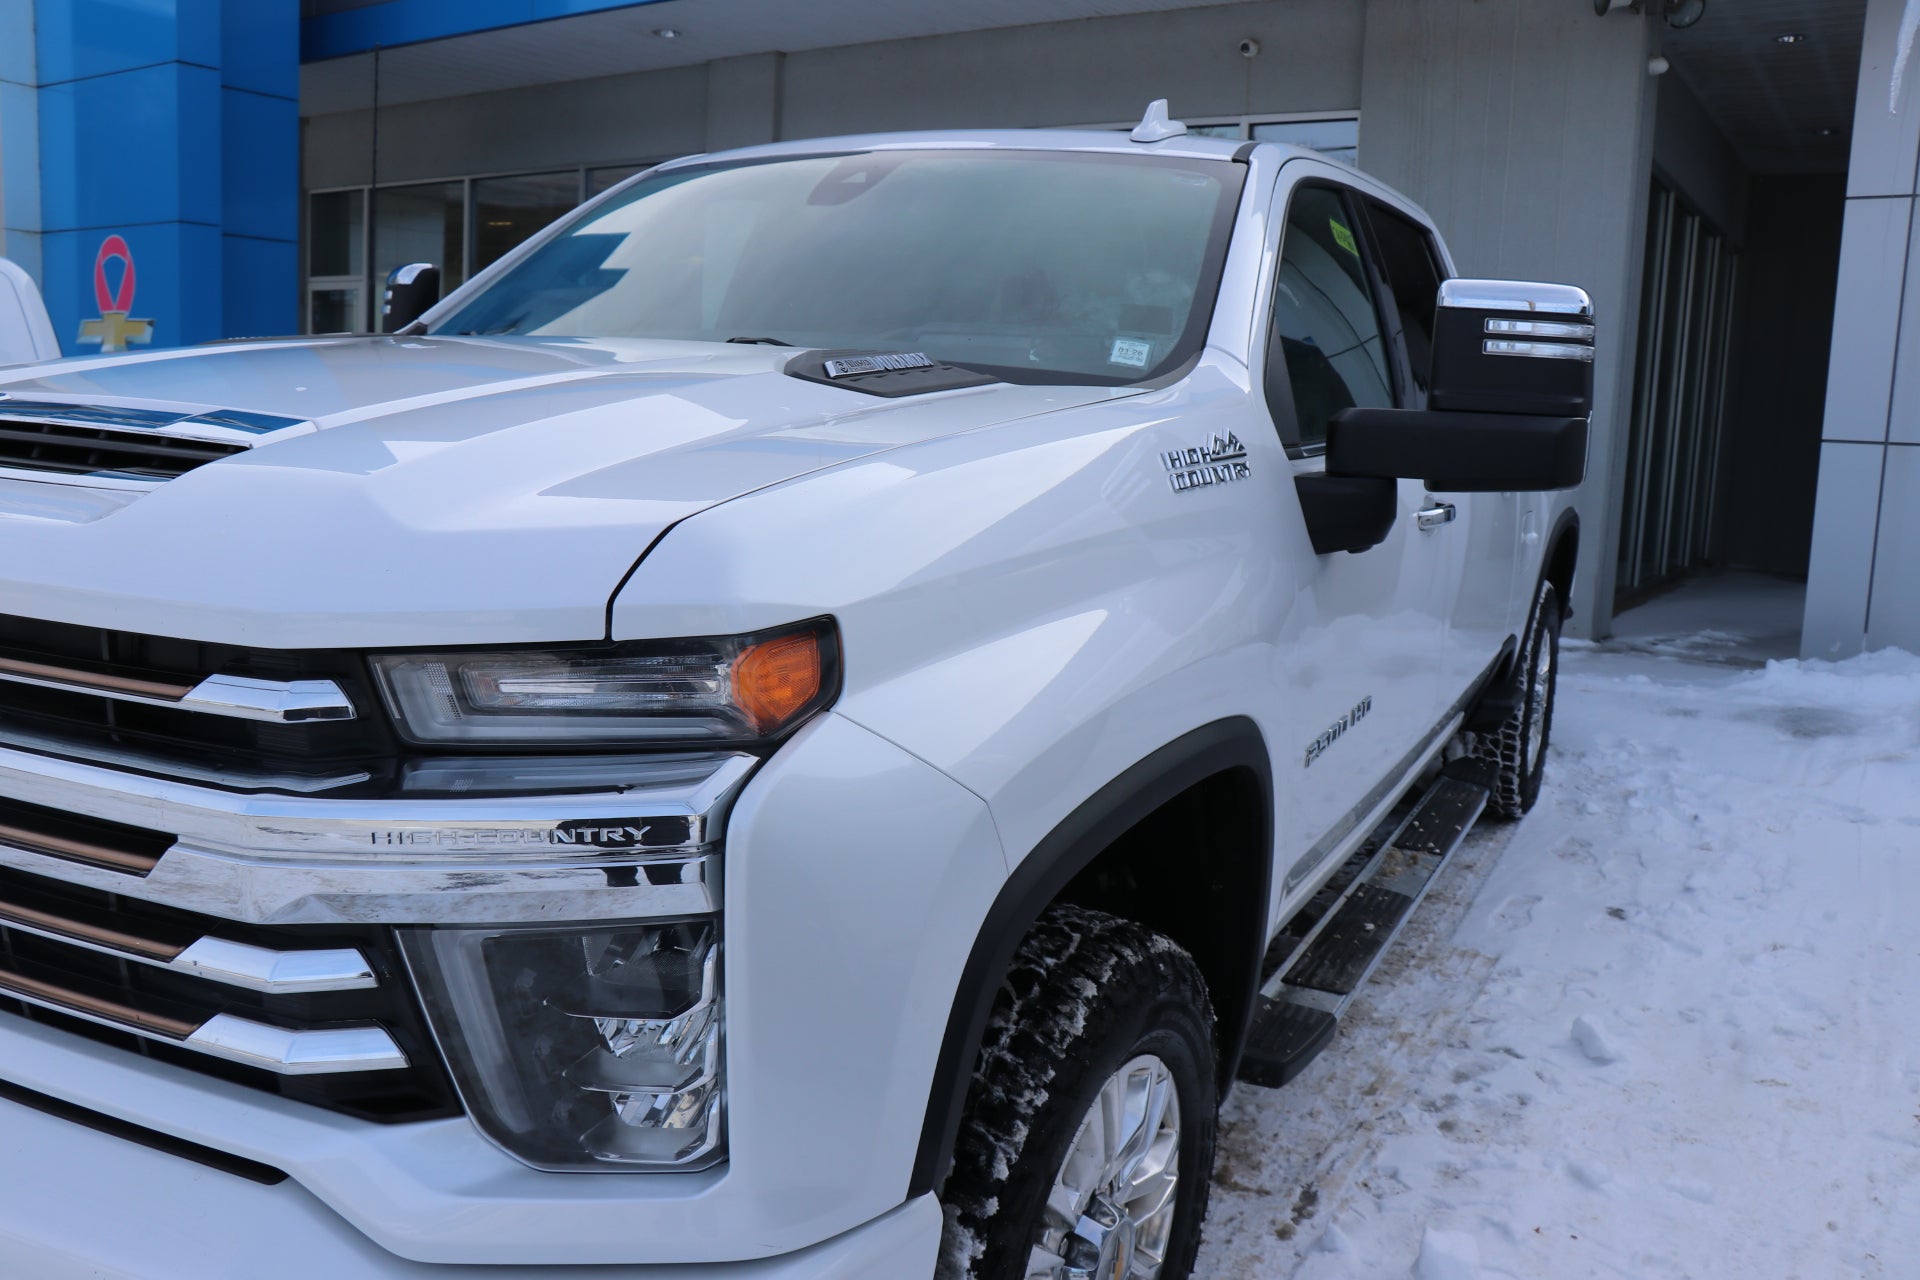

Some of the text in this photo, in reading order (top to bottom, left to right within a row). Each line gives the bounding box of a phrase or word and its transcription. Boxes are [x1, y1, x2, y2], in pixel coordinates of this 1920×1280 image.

[1161, 446, 1211, 471] HIGH
[1169, 461, 1250, 493] COUNTRY
[370, 825, 652, 845] HIGH COUNTRY
